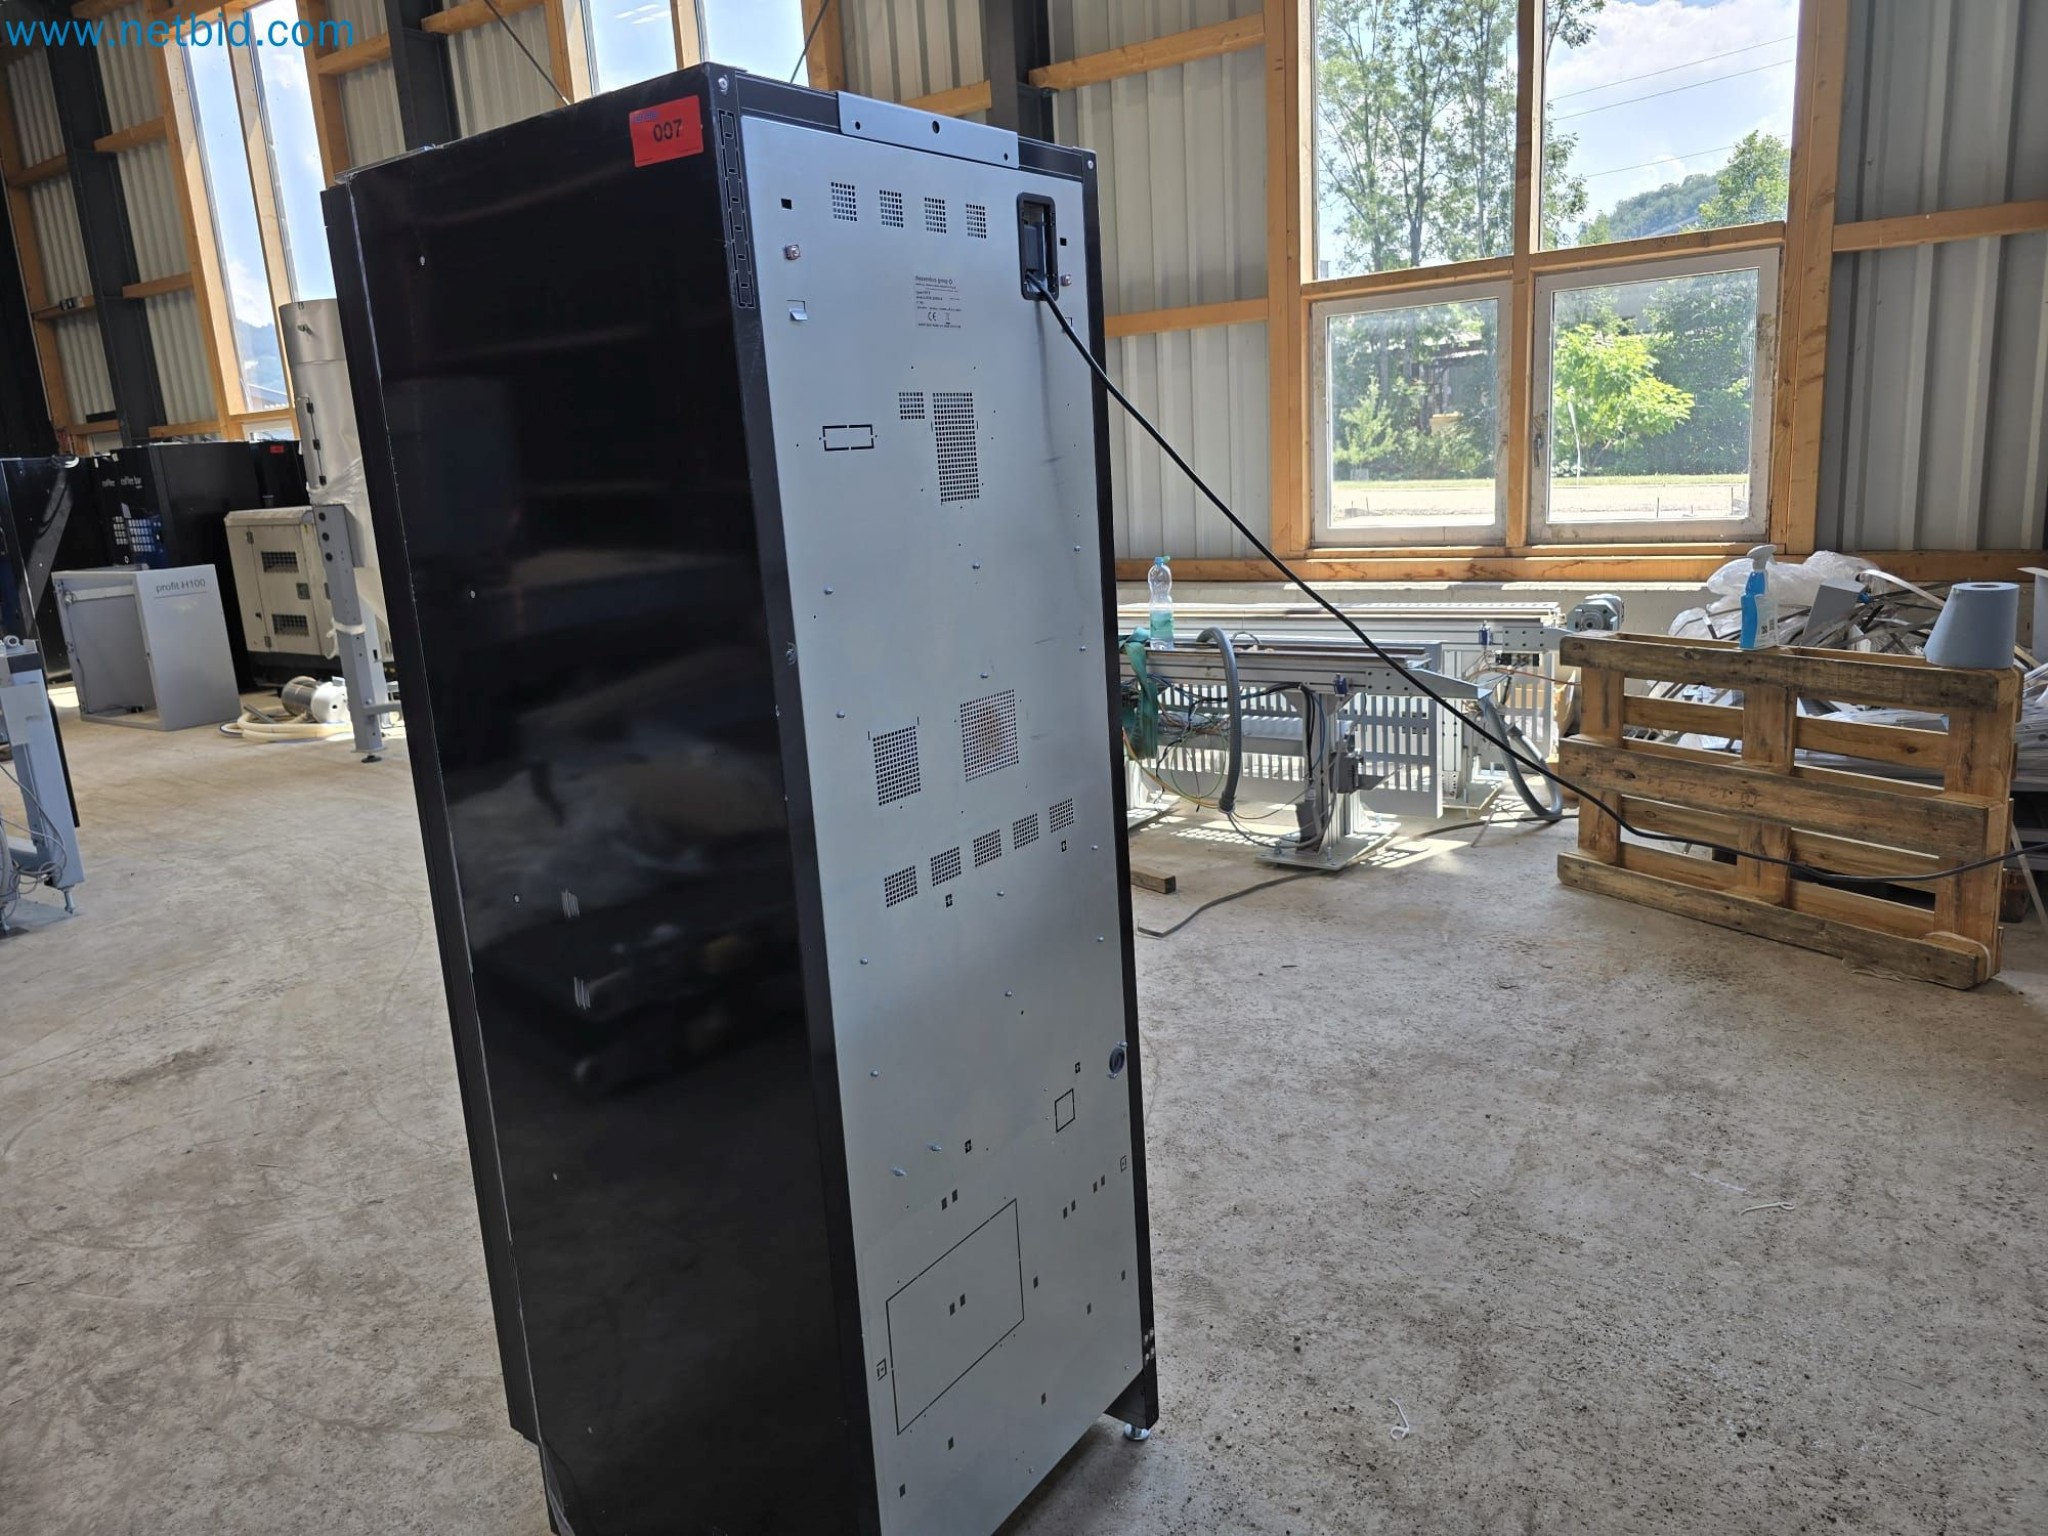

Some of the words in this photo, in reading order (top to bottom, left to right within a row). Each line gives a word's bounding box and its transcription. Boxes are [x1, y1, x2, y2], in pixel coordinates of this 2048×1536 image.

[653, 118, 682, 142] 007
[156, 581, 180, 594] profit
[181, 577, 206, 589] H100
